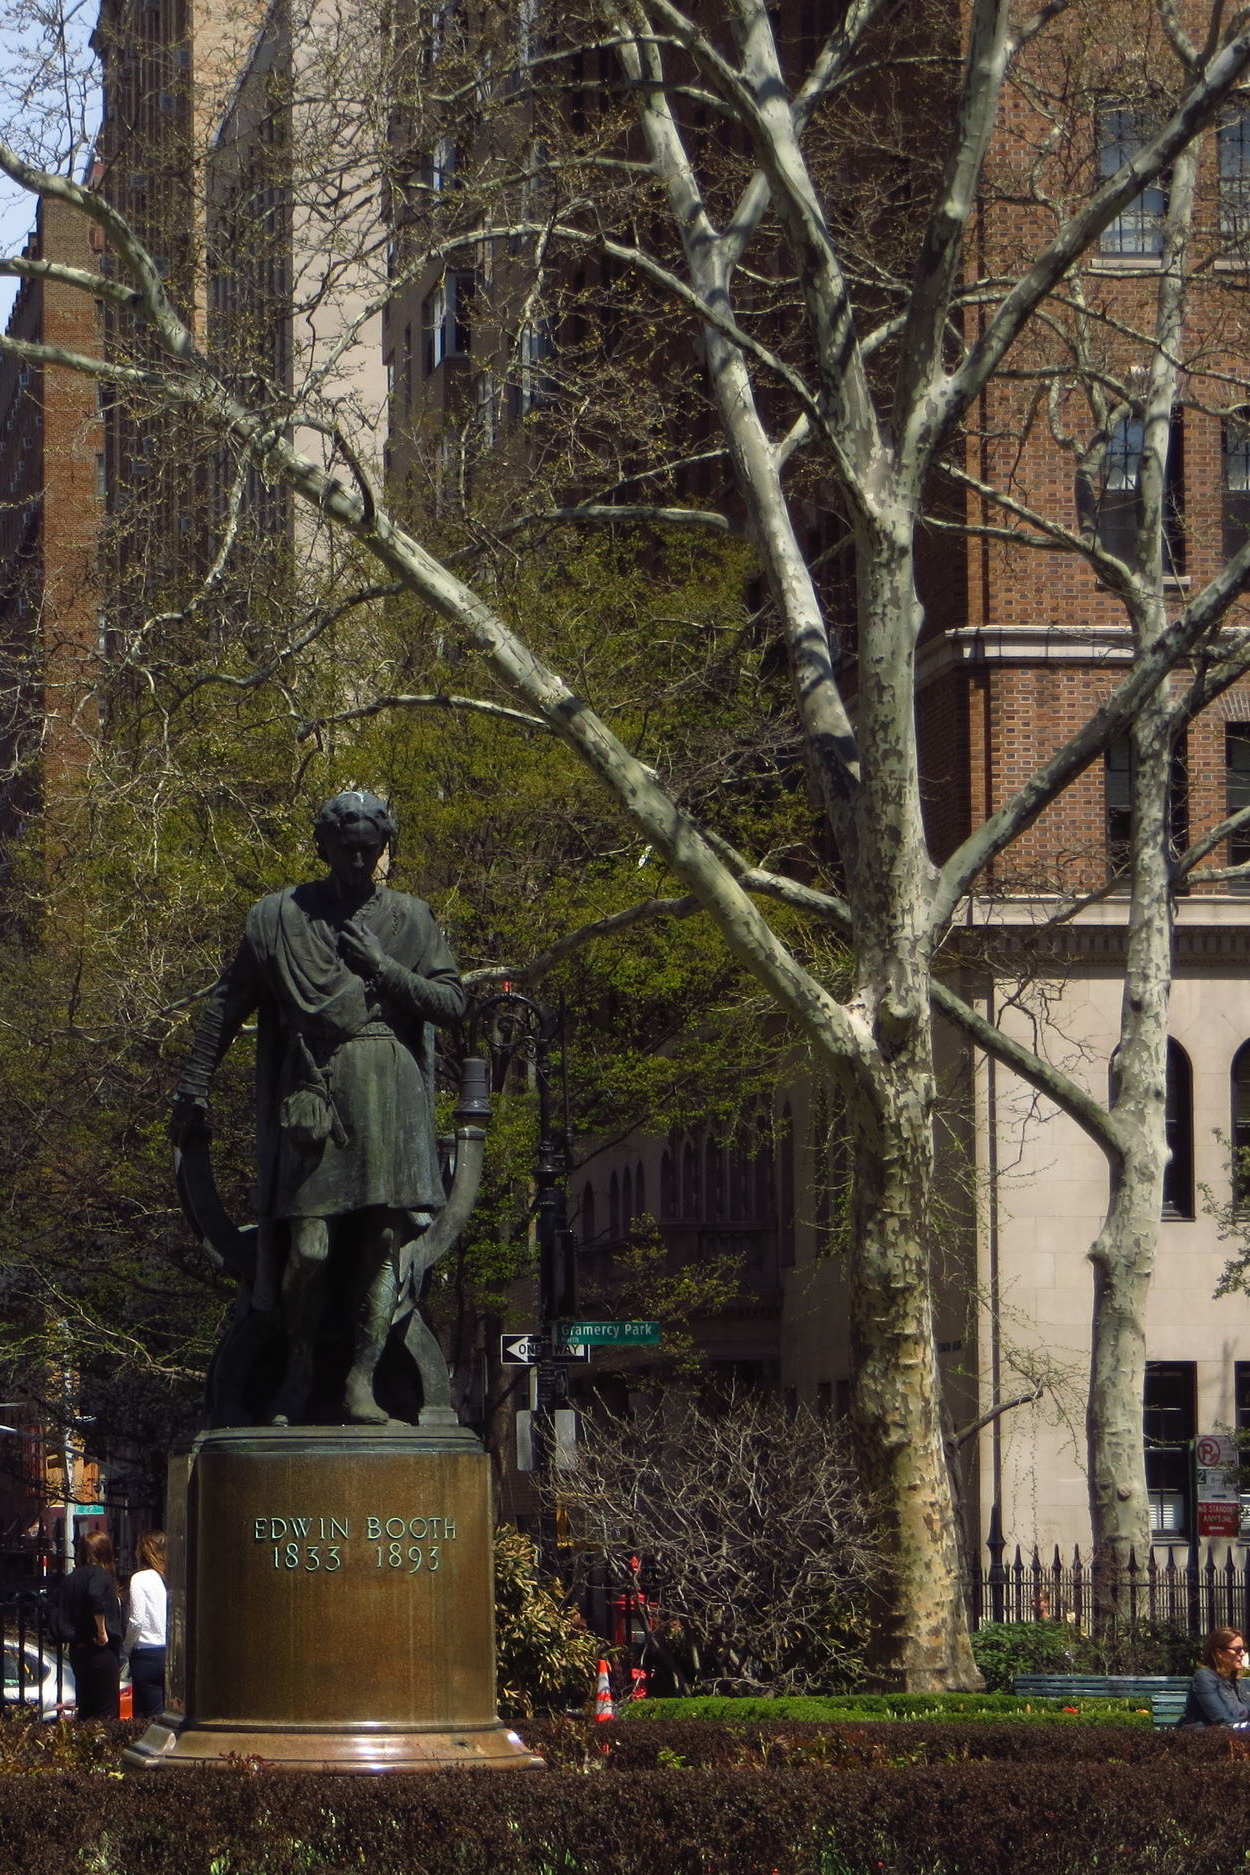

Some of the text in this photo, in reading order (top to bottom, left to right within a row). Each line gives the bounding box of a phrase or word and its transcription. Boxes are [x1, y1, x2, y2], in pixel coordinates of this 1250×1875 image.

[561, 1323, 653, 1339] Gramercy Park
[518, 1343, 579, 1355] ONE WAY
[1198, 1505, 1207, 1513] NO
[1203, 1515, 1232, 1523] ANYTIME
[254, 1517, 458, 1541] EDWIN BOOTH
[272, 1542, 441, 1574] 1833 1893
